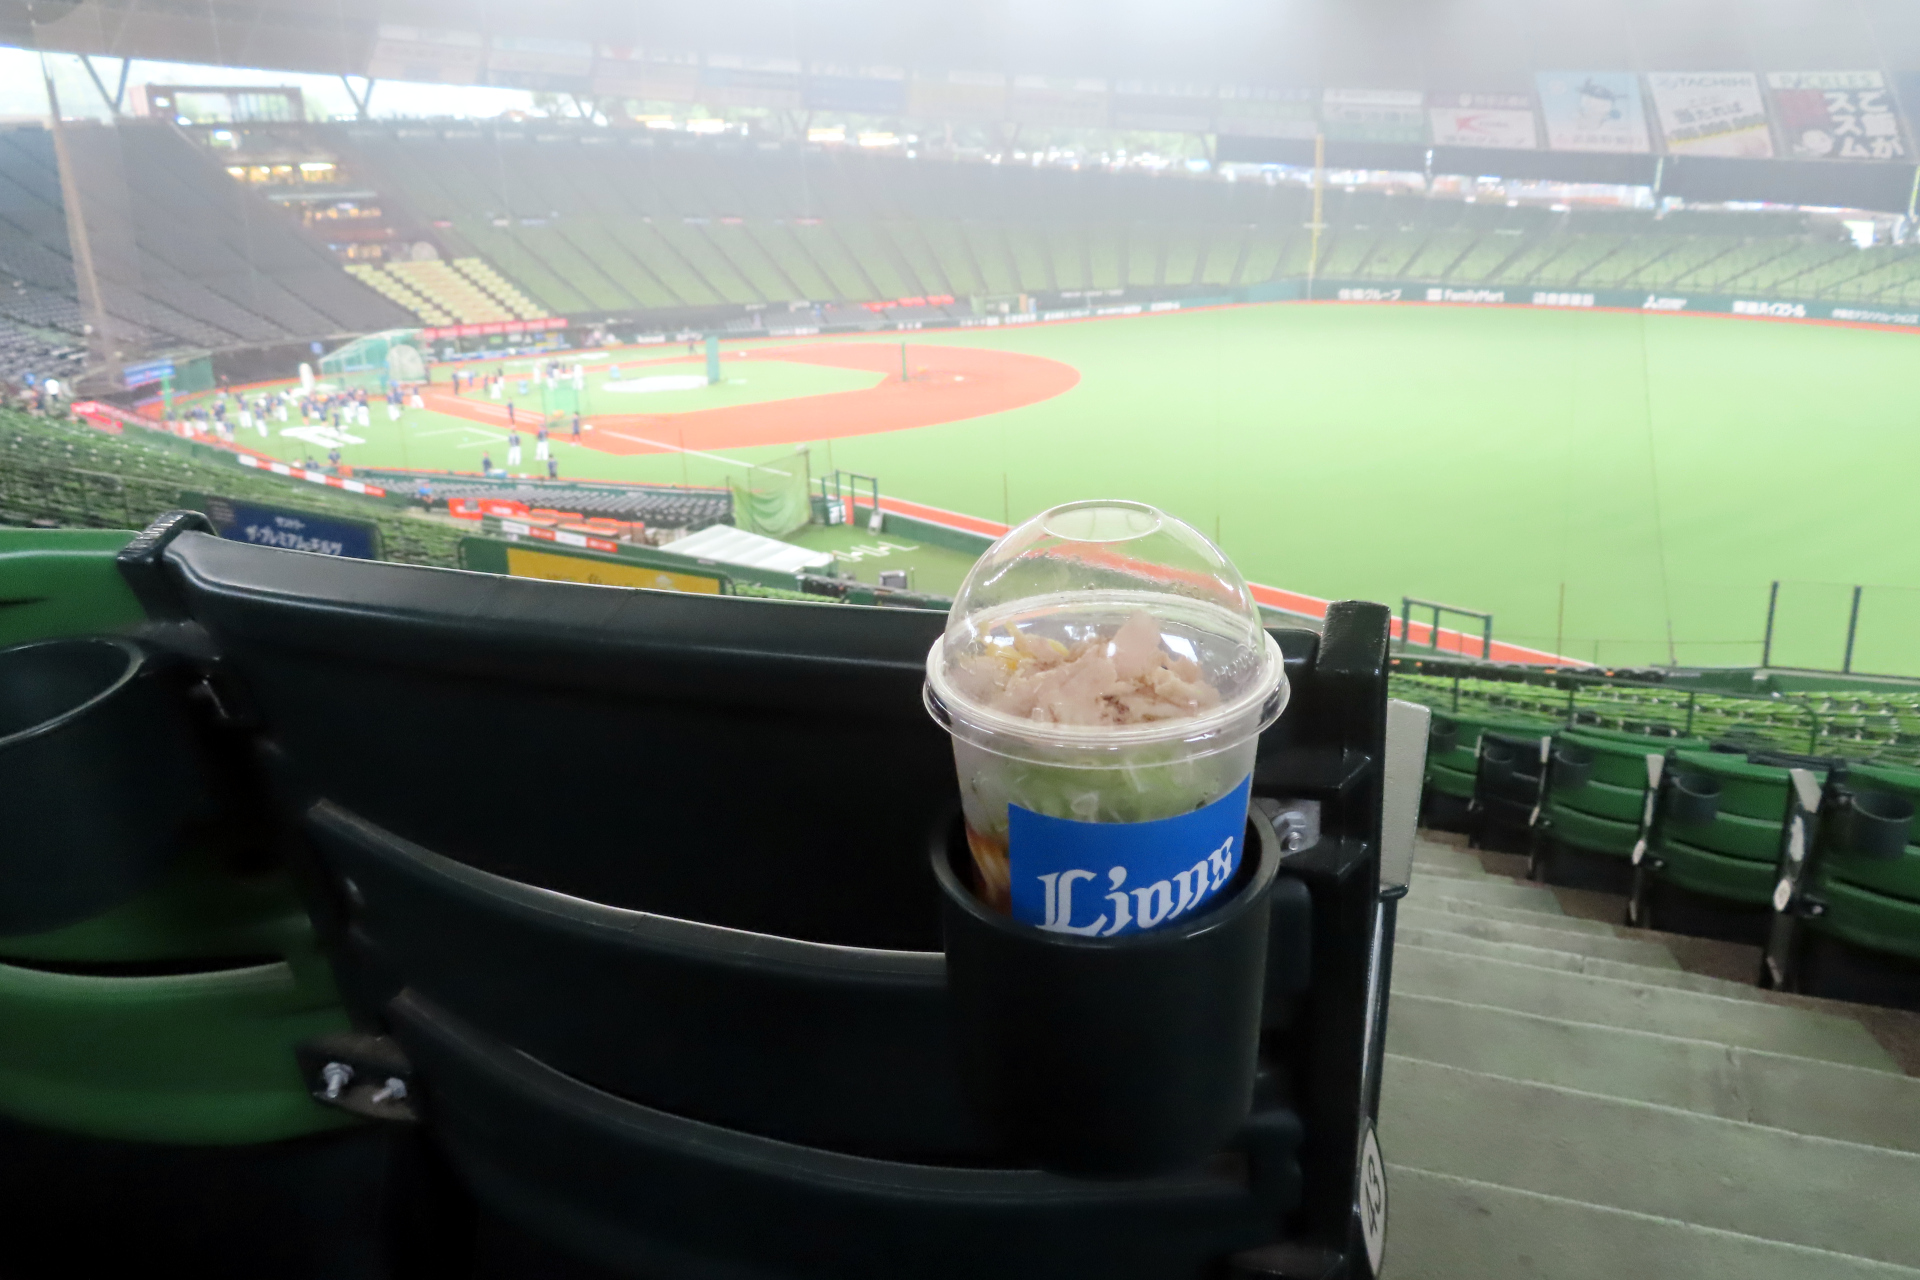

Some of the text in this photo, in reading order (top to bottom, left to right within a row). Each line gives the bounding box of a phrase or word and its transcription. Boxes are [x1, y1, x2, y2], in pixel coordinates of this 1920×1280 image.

[1823, 91, 1872, 158] ススム
[1444, 288, 1505, 303] FamilyMart
[1034, 835, 1234, 937] Lions
